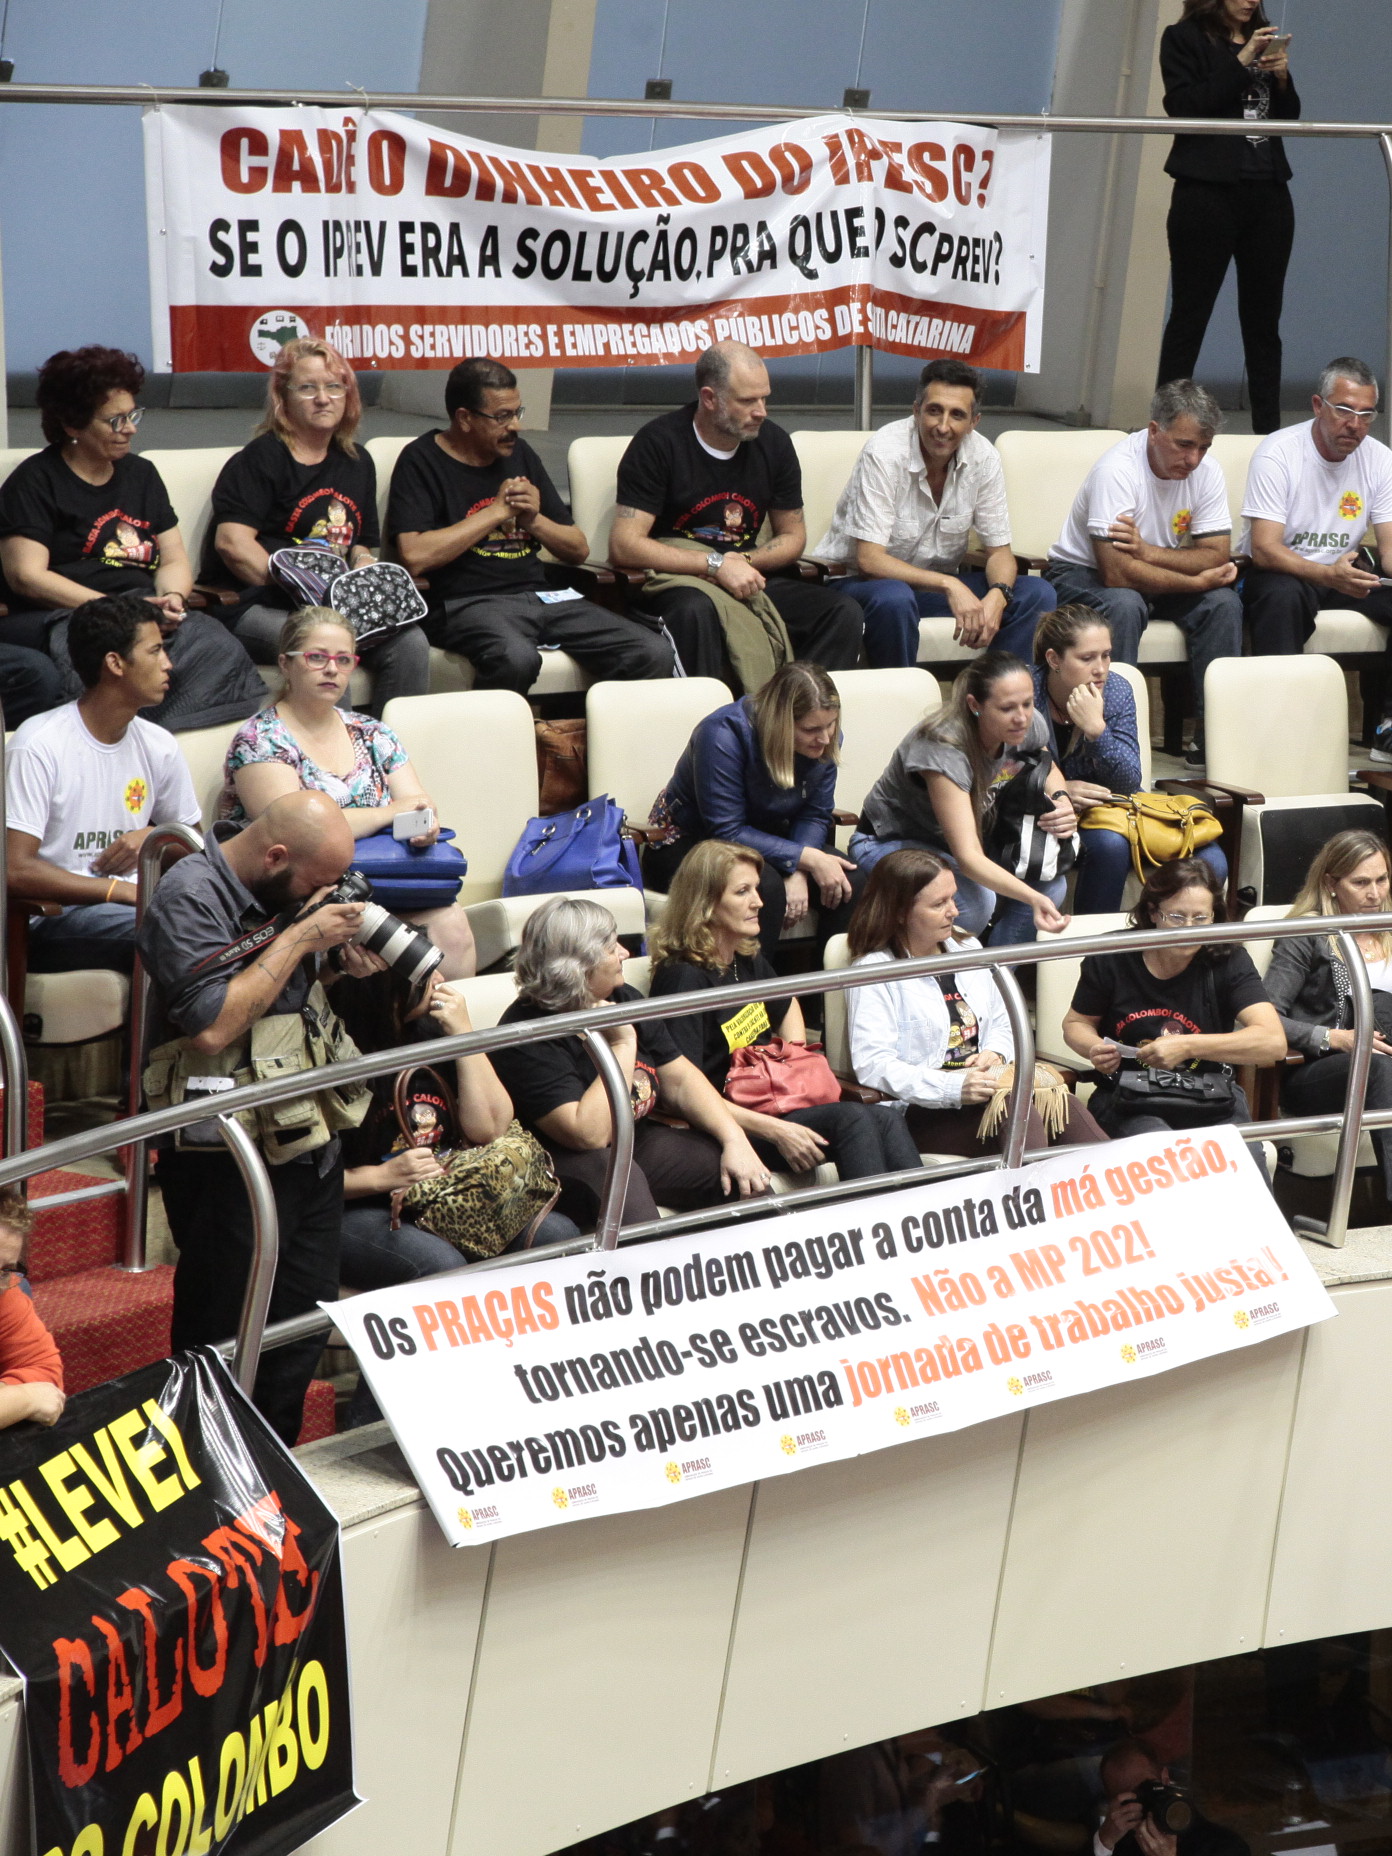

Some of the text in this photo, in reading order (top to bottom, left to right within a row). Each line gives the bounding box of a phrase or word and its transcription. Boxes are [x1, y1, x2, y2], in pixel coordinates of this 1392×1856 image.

[219, 116, 995, 212] CADÊ O DINHEIRO DO IPESC?
[208, 218, 262, 278] SE
[276, 218, 307, 278] O
[399, 220, 470, 278] ERA
[477, 225, 502, 278] A
[889, 215, 1002, 286] SCPREV?
[409, 324, 544, 358] SERVIDORES
[547, 324, 560, 357] E
[562, 320, 712, 356] EMPREGADOS
[714, 308, 832, 347] PÚBLICOS
[834, 302, 865, 337] DE
[887, 310, 976, 354] CATARINA
[1290, 531, 1350, 548] APRASC
[252, 926, 275, 943] EOS
[363, 1137, 1238, 1361] Os PRAÇAS não podem pagar a conta da má gestão,
[514, 1219, 1157, 1404] tornando-se escravos. Não a MP 202!
[1249, 1302, 1280, 1320] APRASC
[1136, 1337, 1166, 1354] APRASC
[436, 1420, 627, 1497] Queremos
[629, 1388, 762, 1453] apenas
[761, 1369, 844, 1422] uma
[840, 1334, 984, 1406] jornada
[983, 1322, 1032, 1366] de
[1029, 1279, 1186, 1352] trabalho
[1022, 1370, 1053, 1388] APRASC
[910, 1401, 940, 1418] APRASC
[796, 1429, 826, 1447] APRASC
[681, 1457, 711, 1474] APRASC
[567, 1483, 597, 1500] APRASC
[471, 1505, 499, 1520] APRASC
